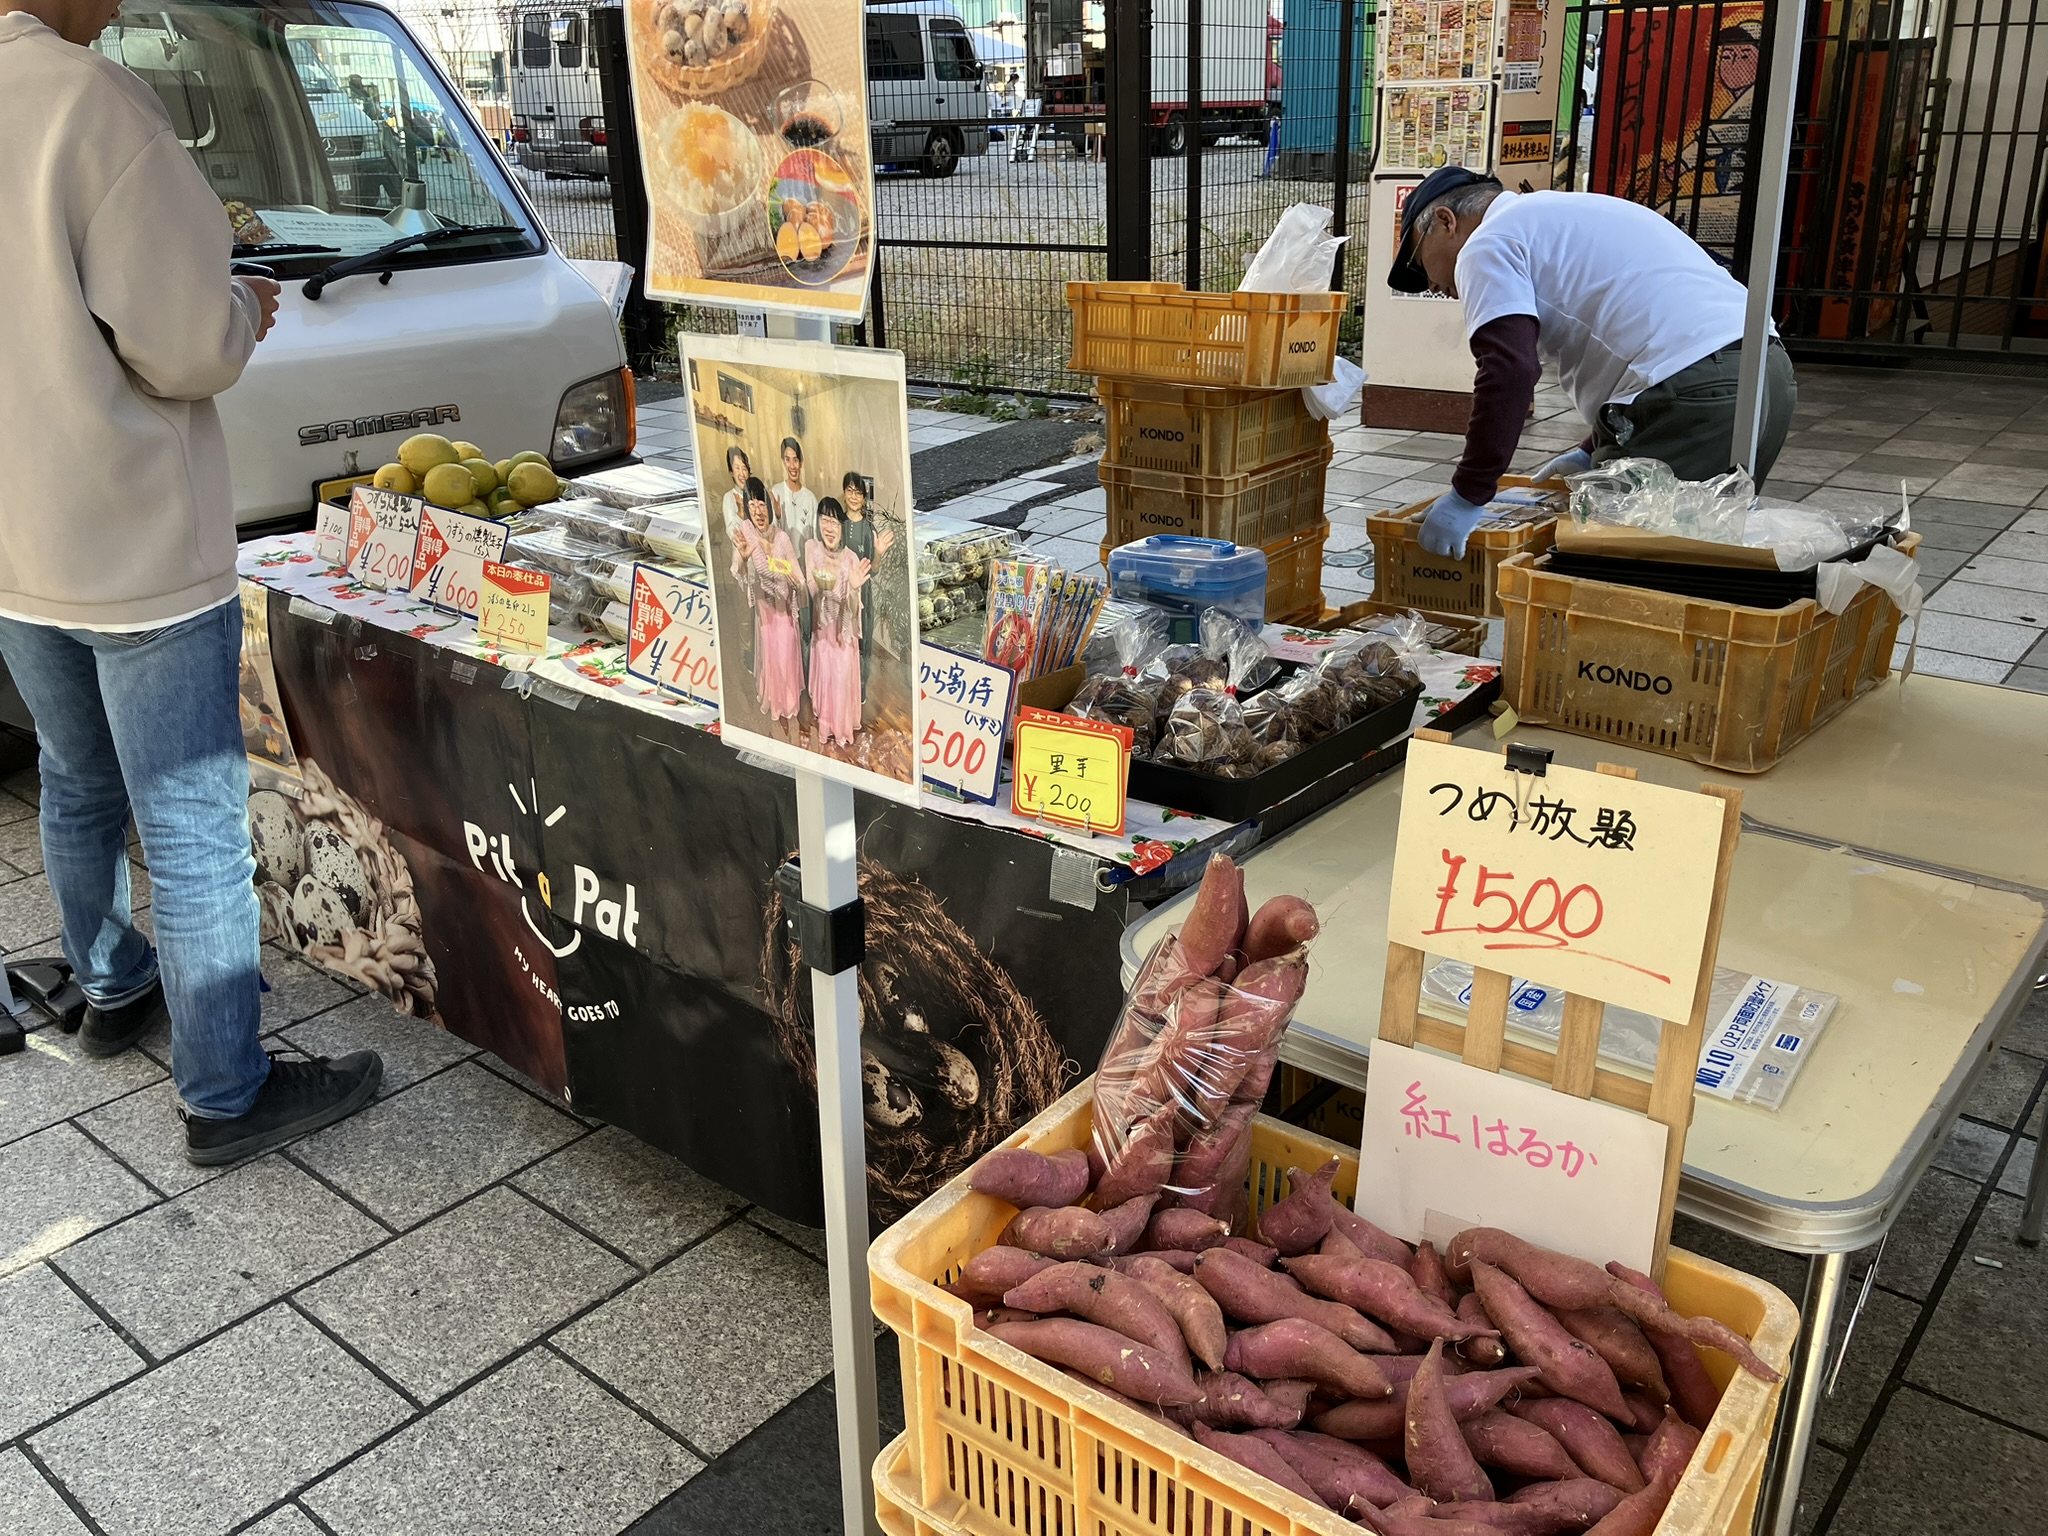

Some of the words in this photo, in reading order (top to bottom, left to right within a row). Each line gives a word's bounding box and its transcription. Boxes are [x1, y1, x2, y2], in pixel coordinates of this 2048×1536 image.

[1288, 340, 1316, 354] KONDO
[298, 404, 461, 446] SAMBAR
[1139, 427, 1185, 442] KONDO
[322, 516, 343, 535] ¥100
[1139, 512, 1184, 528] KONDO
[360, 542, 410, 581] ¥200
[487, 564, 545, 587] 本日の奉仕品
[1412, 566, 1462, 582] KONDO
[429, 565, 478, 609] ¥600
[666, 584, 713, 625] うずら
[1577, 660, 1673, 696] KONDO
[1049, 754, 1088, 779] 里芋
[1429, 783, 1637, 851] つめ放題
[463, 820, 523, 889] Pit
[573, 863, 640, 949] Pat
[1434, 849, 1604, 939] ¥500
[514, 946, 530, 972] MY
[532, 972, 563, 1015] HEART
[567, 1005, 604, 1023] GOES
[604, 999, 620, 1019] TO
[1400, 1080, 1599, 1177] 紅はるか
